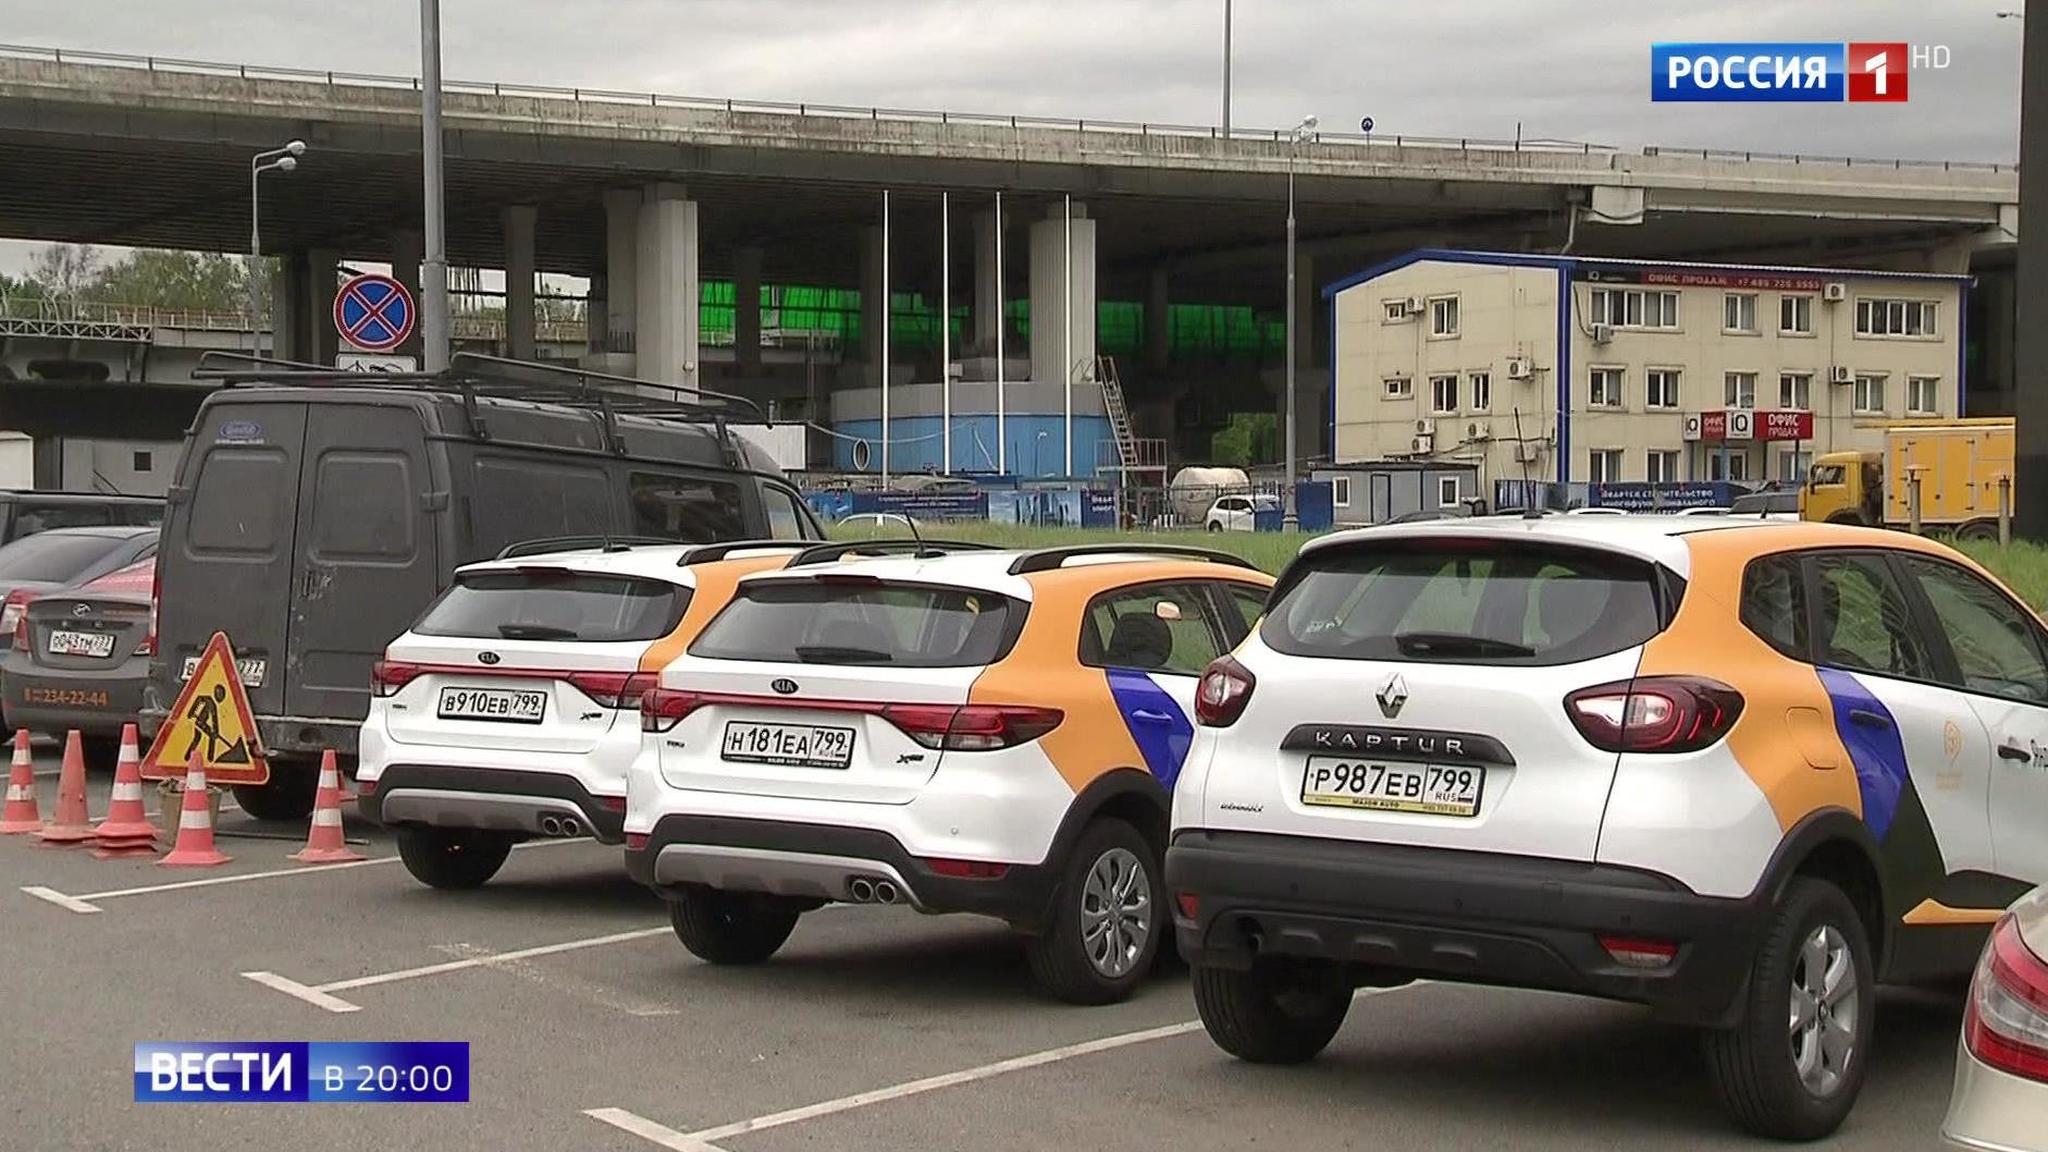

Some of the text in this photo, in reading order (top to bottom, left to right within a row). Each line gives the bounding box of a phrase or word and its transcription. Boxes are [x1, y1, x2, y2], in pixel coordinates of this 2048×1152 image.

[1768, 413, 1799, 426] ОФИС
[774, 681, 795, 692] KIA
[730, 728, 846, 754] Н181ЕА 799
[1315, 732, 1464, 755] KAPTUR
[1314, 763, 1472, 797] Р987ЕВ 799
[1435, 791, 1457, 801] RUS
